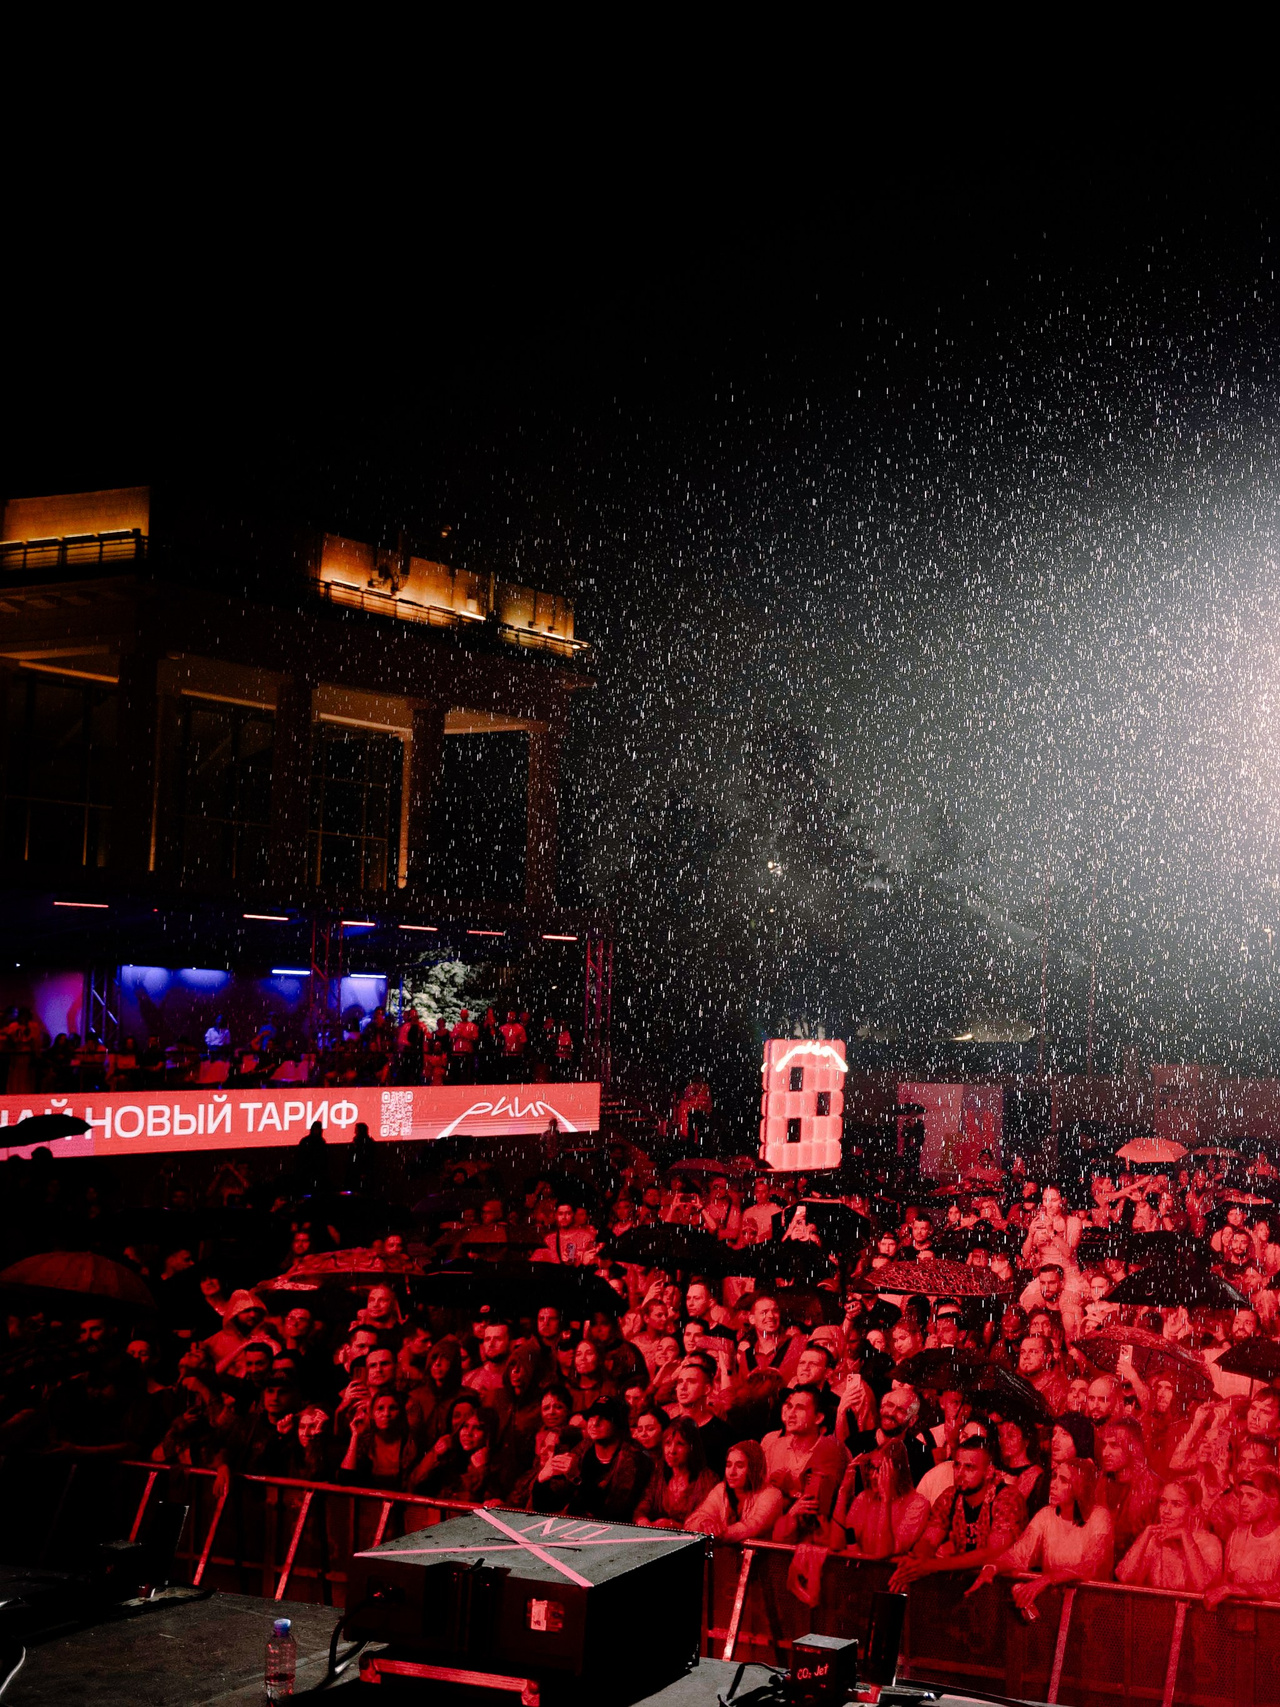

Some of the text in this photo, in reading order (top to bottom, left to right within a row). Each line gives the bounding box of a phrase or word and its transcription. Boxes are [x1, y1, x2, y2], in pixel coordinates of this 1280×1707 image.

[85, 1094, 232, 1139] НОВЫЙ
[239, 1100, 359, 1133] ТАРИФ
[814, 1663, 829, 1677] Jet
